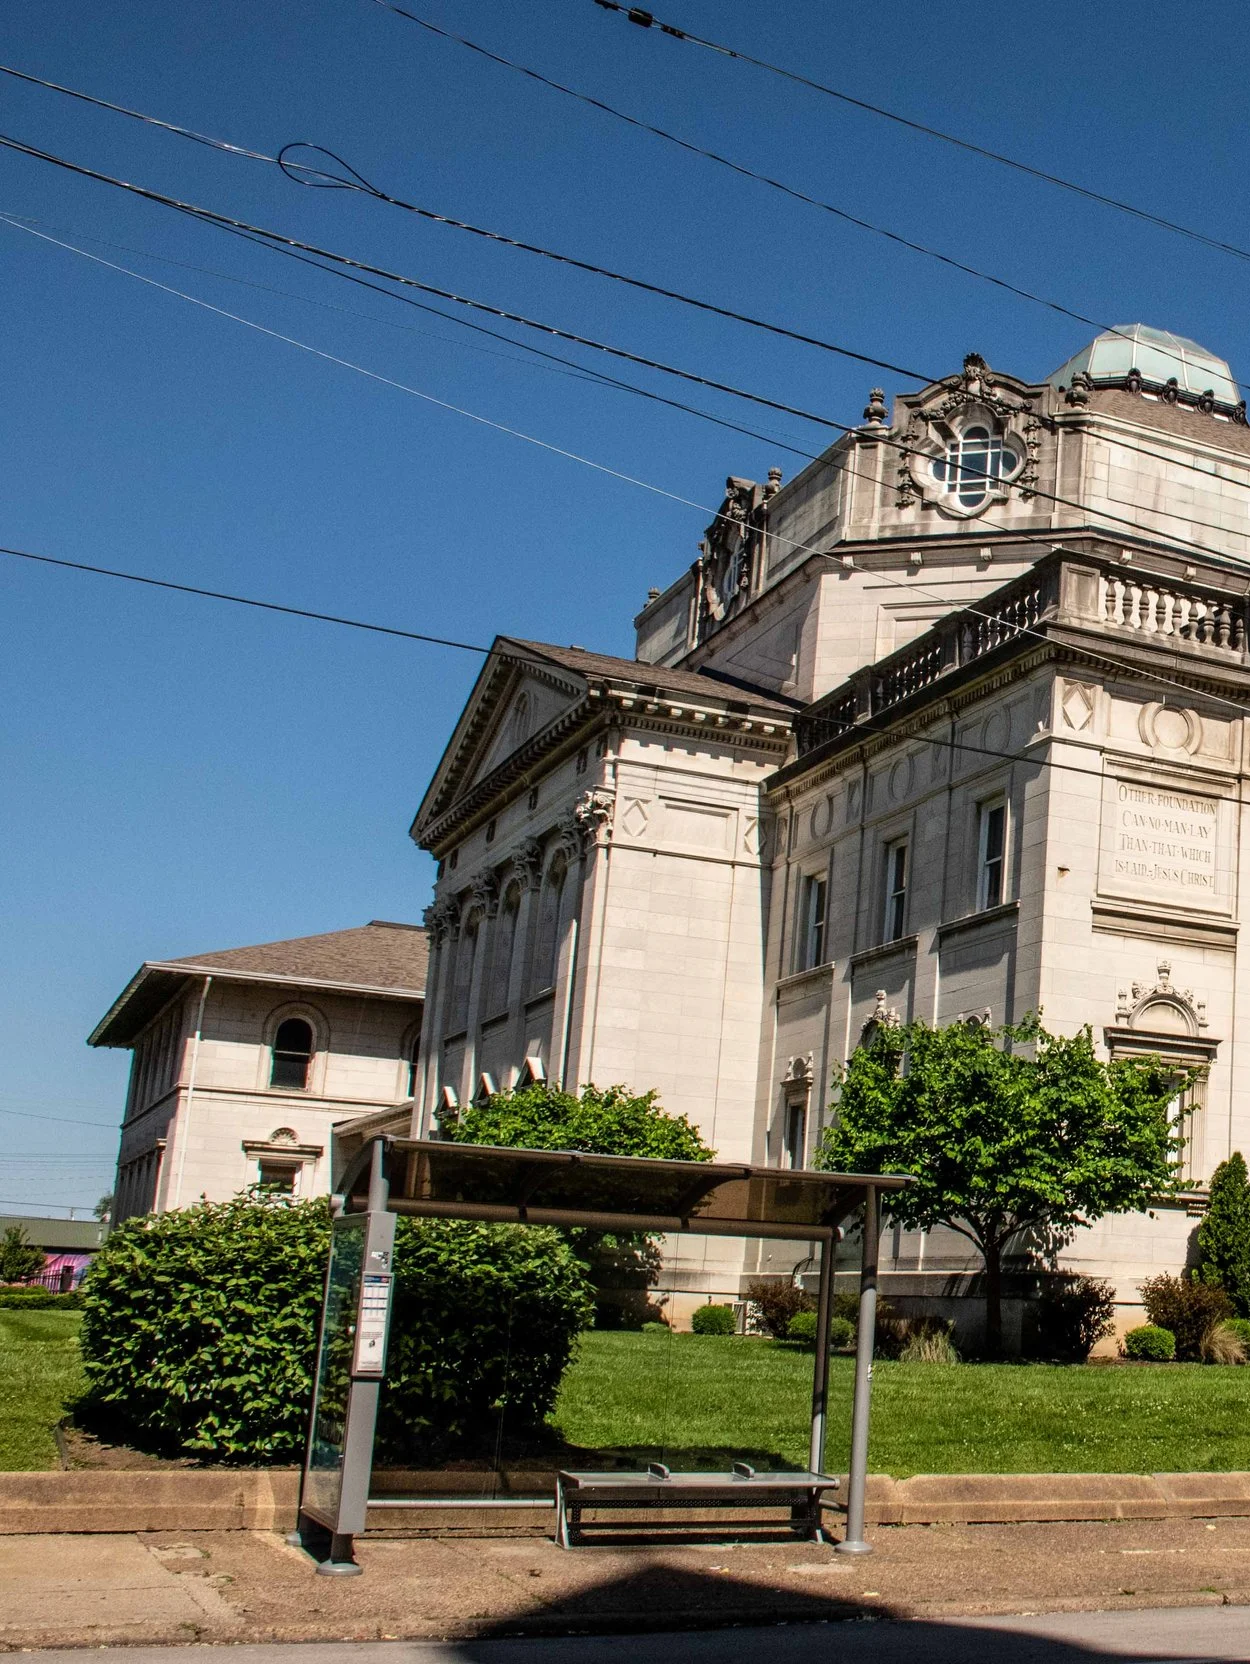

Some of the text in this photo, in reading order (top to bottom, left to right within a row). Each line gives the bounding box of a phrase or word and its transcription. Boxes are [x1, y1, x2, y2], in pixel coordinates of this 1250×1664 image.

[1119, 784, 1216, 815] OTHER FOUNDATION
[1122, 810, 1146, 827] CAN
[1148, 816, 1161, 830] NO
[1164, 819, 1187, 835] MAN
[1119, 833, 1211, 863] THAN THAT WHICH
